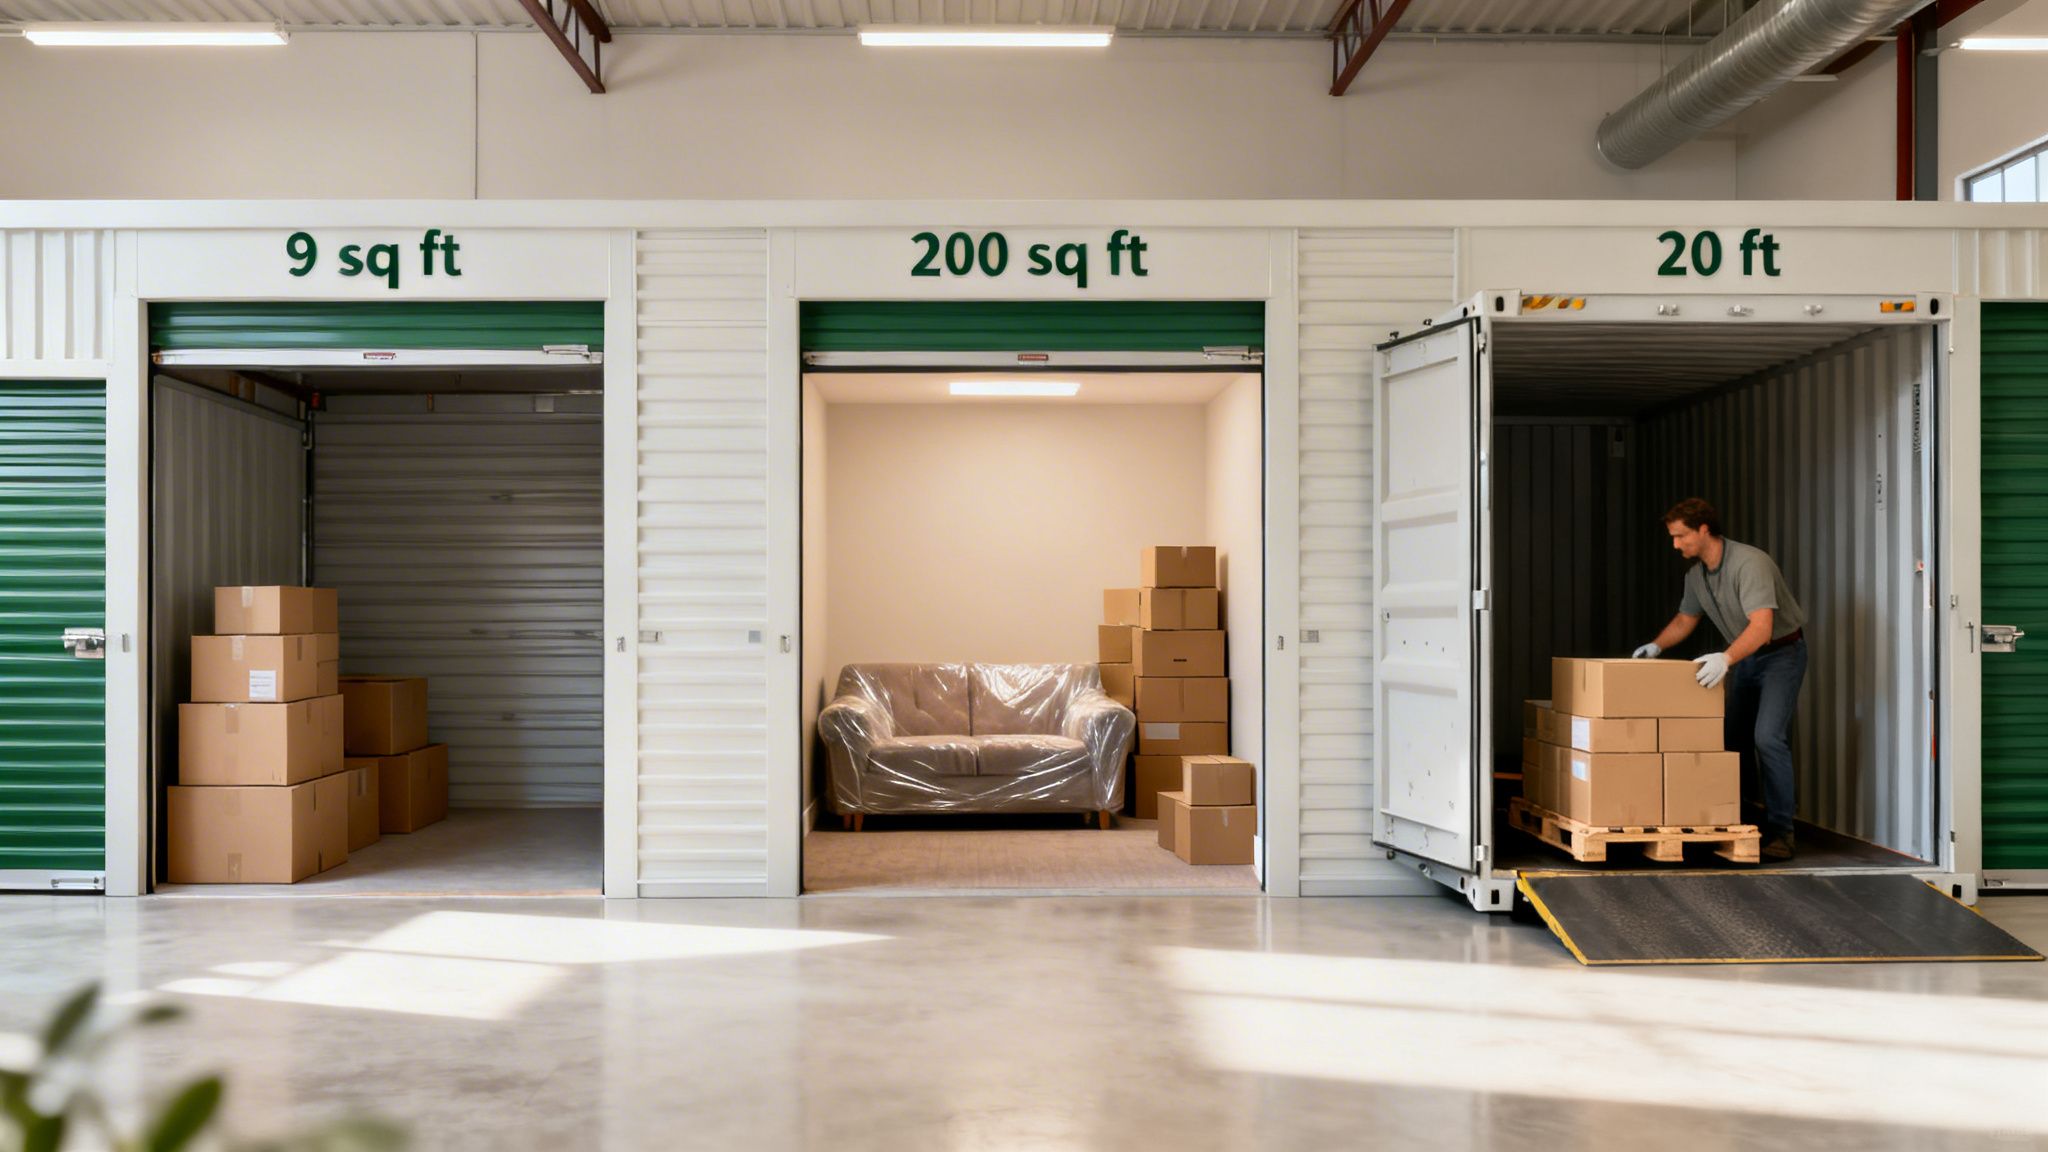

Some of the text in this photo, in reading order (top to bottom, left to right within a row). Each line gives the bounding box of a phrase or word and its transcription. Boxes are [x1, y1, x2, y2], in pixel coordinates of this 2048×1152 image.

[287, 229, 462, 289] 9 sq ft
[911, 229, 1148, 289] 200 sq ft
[1657, 229, 1781, 276] 20 ft
